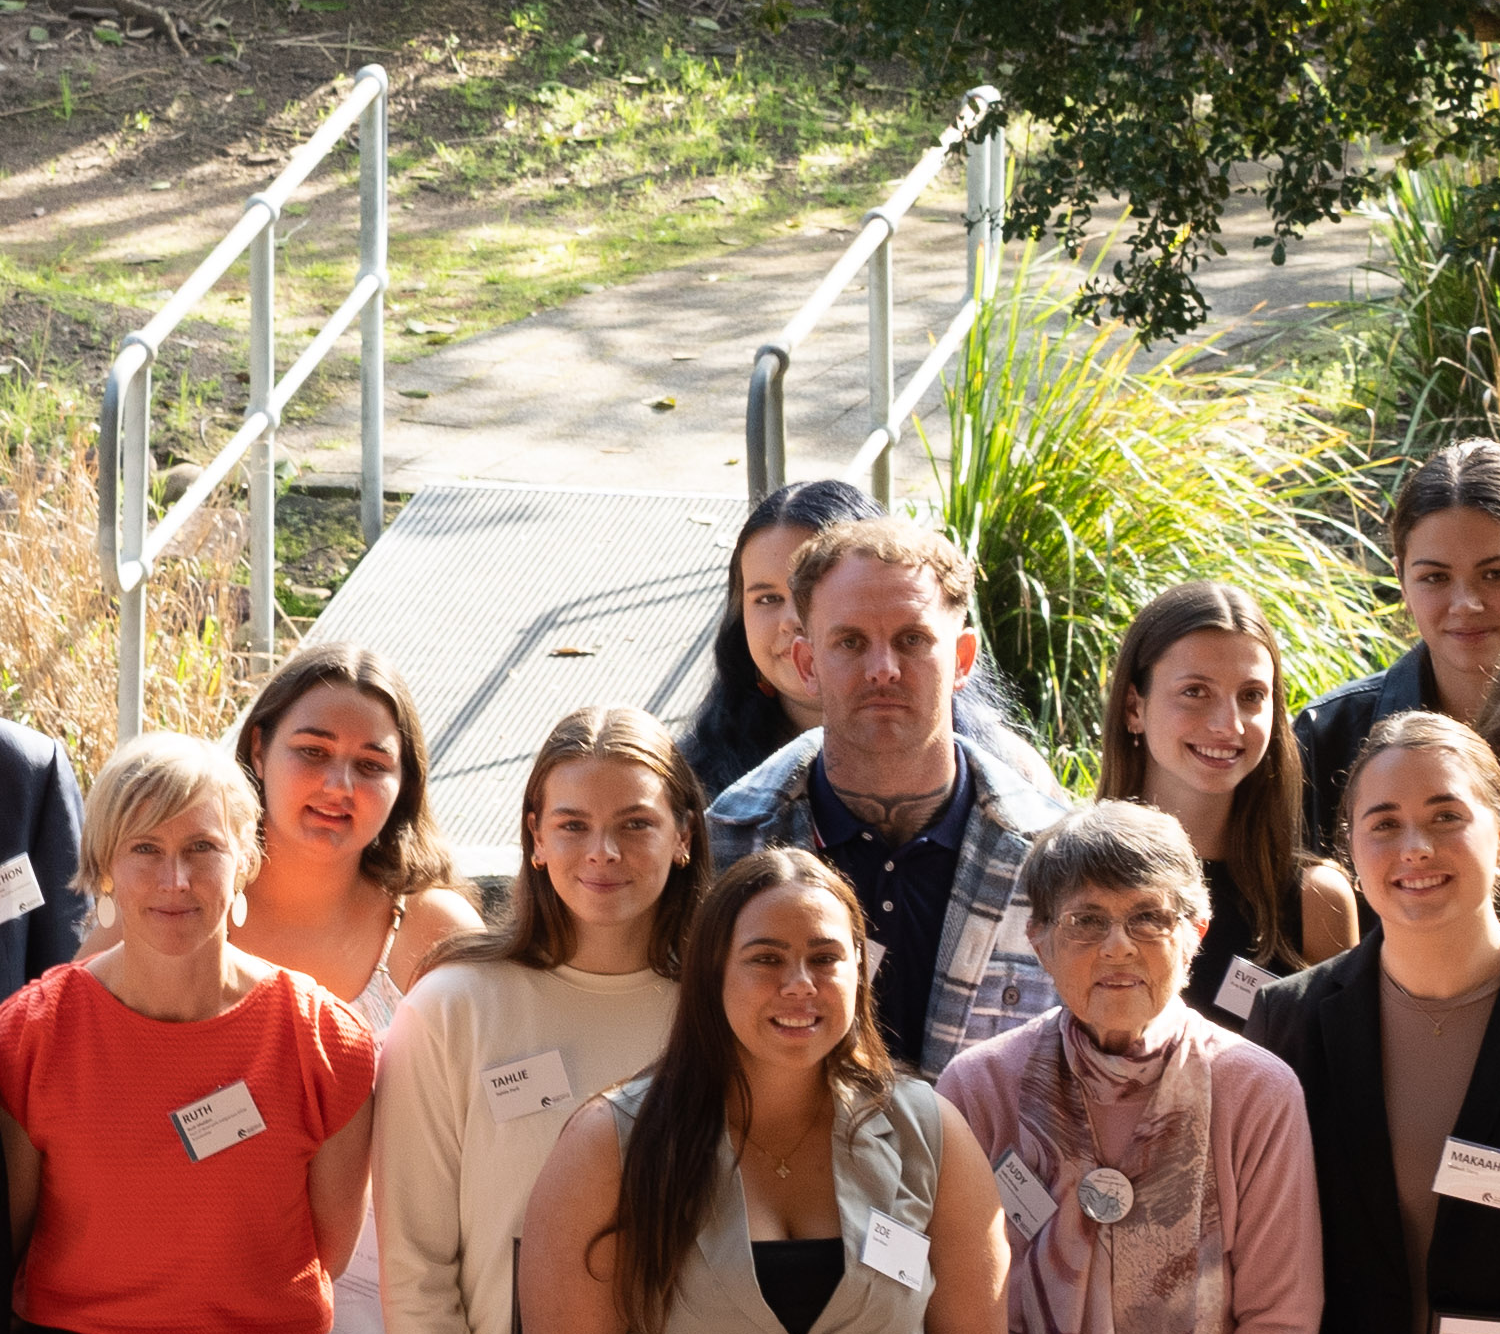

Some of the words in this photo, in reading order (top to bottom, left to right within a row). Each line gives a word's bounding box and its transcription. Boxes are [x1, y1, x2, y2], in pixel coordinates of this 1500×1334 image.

[1234, 969, 1258, 987] EVIE
[491, 1069, 529, 1088] TAHLIE
[182, 1103, 213, 1124] RUTH
[1005, 1160, 1028, 1186] JUDY
[874, 1222, 892, 1239] ZOE
